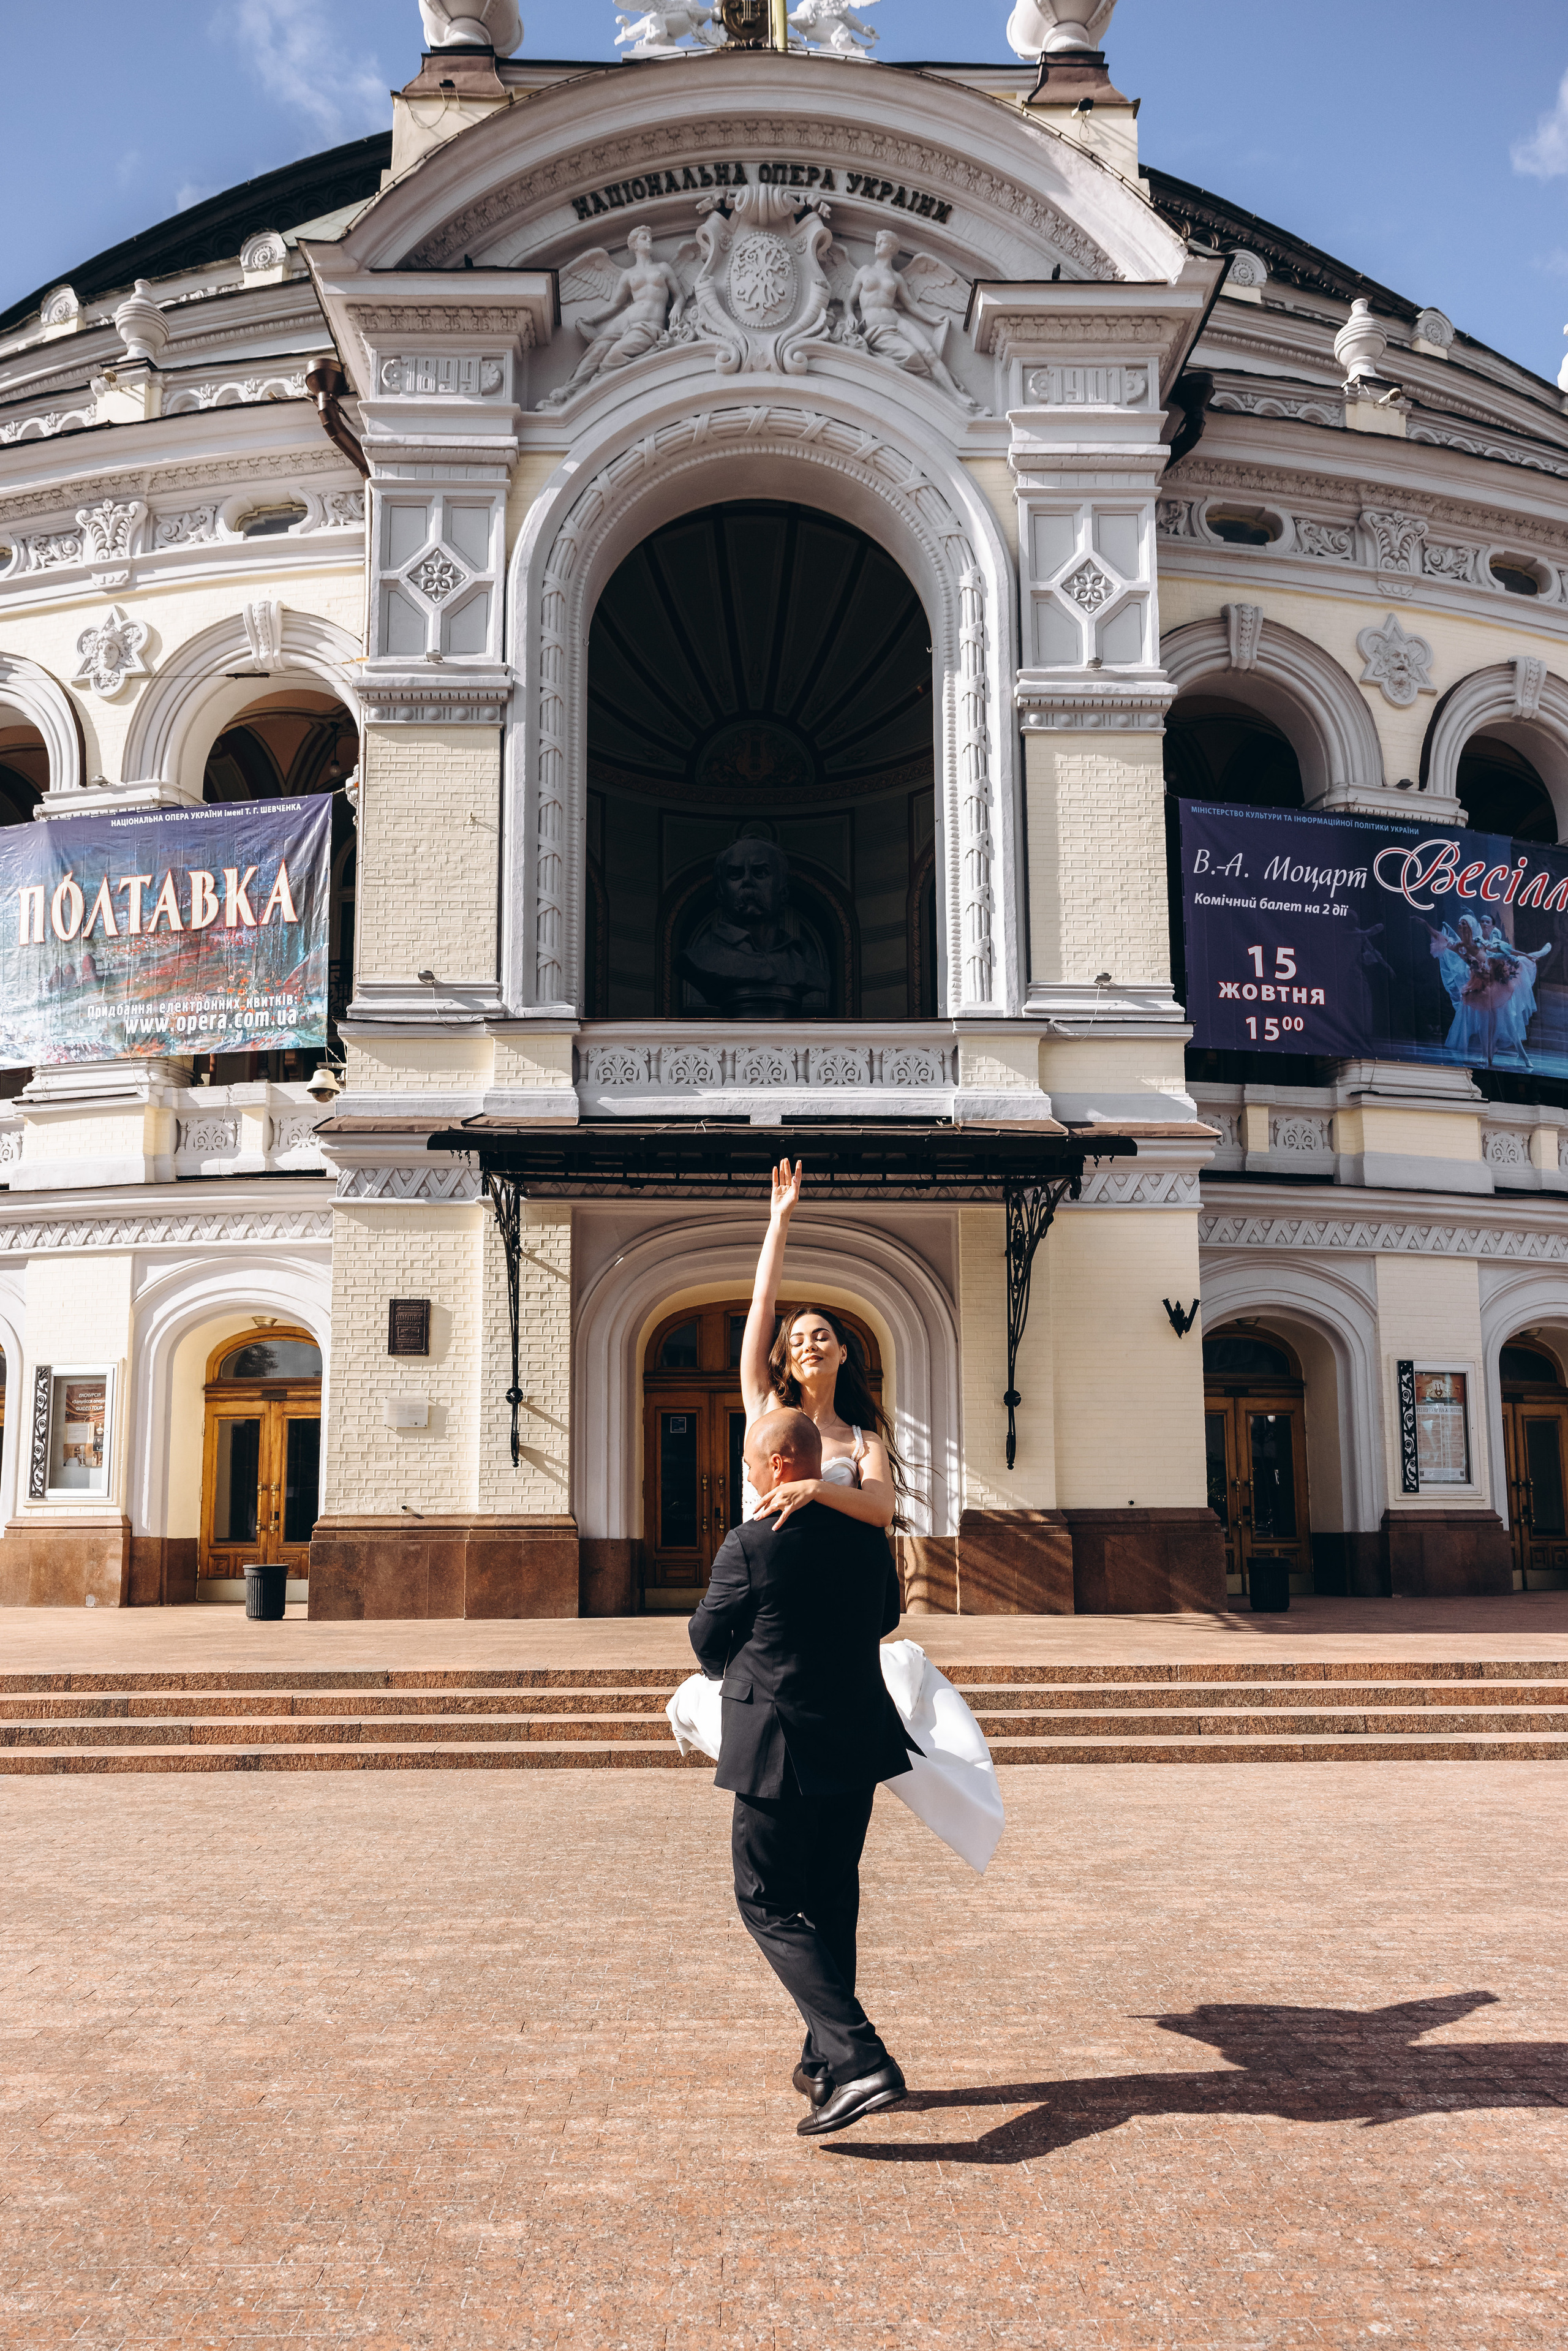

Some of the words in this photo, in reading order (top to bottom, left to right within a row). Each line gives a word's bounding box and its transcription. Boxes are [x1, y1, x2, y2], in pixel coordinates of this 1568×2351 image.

[572, 163, 748, 221] НАЦІОНАЛЬНА
[758, 163, 835, 191] ОПЕРА
[111, 815, 164, 827] НАЦІОНАЛЬНА
[165, 812, 189, 822] ОПЕРА
[190, 809, 222, 820] УКРАЇНИ
[224, 808, 244, 817] імені
[253, 806, 259, 815] Г.
[260, 803, 301, 814] ШЕВЧЕНКА
[1191, 806, 1244, 817] МІНІСТЕРСТВО
[1245, 811, 1283, 821] КУЛЬТУРИ
[1294, 815, 1353, 828] ІНФОРМАЦІЙНОЇ
[1354, 821, 1389, 832] ПОЛІТИКИ
[1390, 825, 1419, 836] УКРАЇНИ
[1264, 856, 1368, 898] Моцарт
[1373, 839, 1568, 911] Весілл
[18, 859, 298, 946] ПОЛТАВКА
[1194, 892, 1256, 908] Комічний
[1259, 897, 1302, 912] балет
[1305, 904, 1319, 914] на
[1322, 904, 1330, 915] 2
[1332, 904, 1349, 916] дії
[1248, 945, 1297, 980] 15
[87, 1002, 153, 1019] Придбання
[159, 998, 240, 1014] електронних
[246, 994, 298, 1009] квитків:
[125, 1006, 298, 1035] www.opera.com.ua
